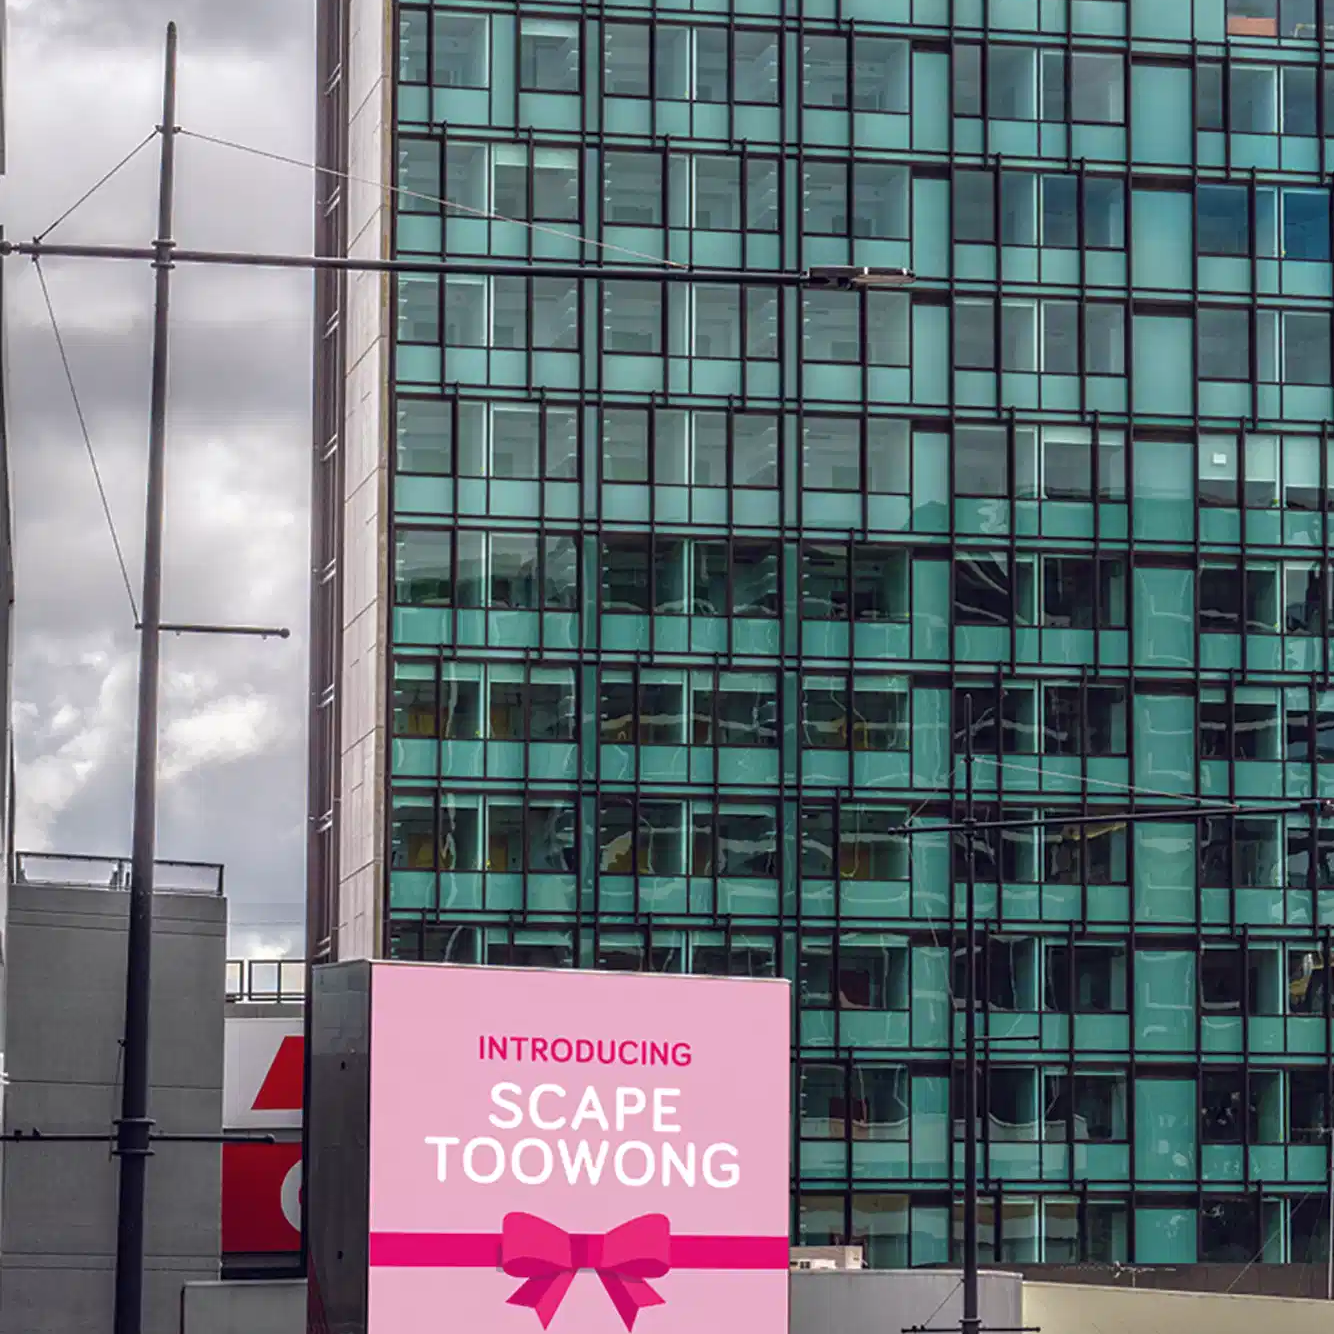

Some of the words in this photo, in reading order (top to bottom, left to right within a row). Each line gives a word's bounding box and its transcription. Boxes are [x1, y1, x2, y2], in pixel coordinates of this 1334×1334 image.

[479, 1036, 692, 1067] INTRODUCING
[489, 1082, 682, 1133] SCAPE
[424, 1136, 741, 1189] TOOWONG
